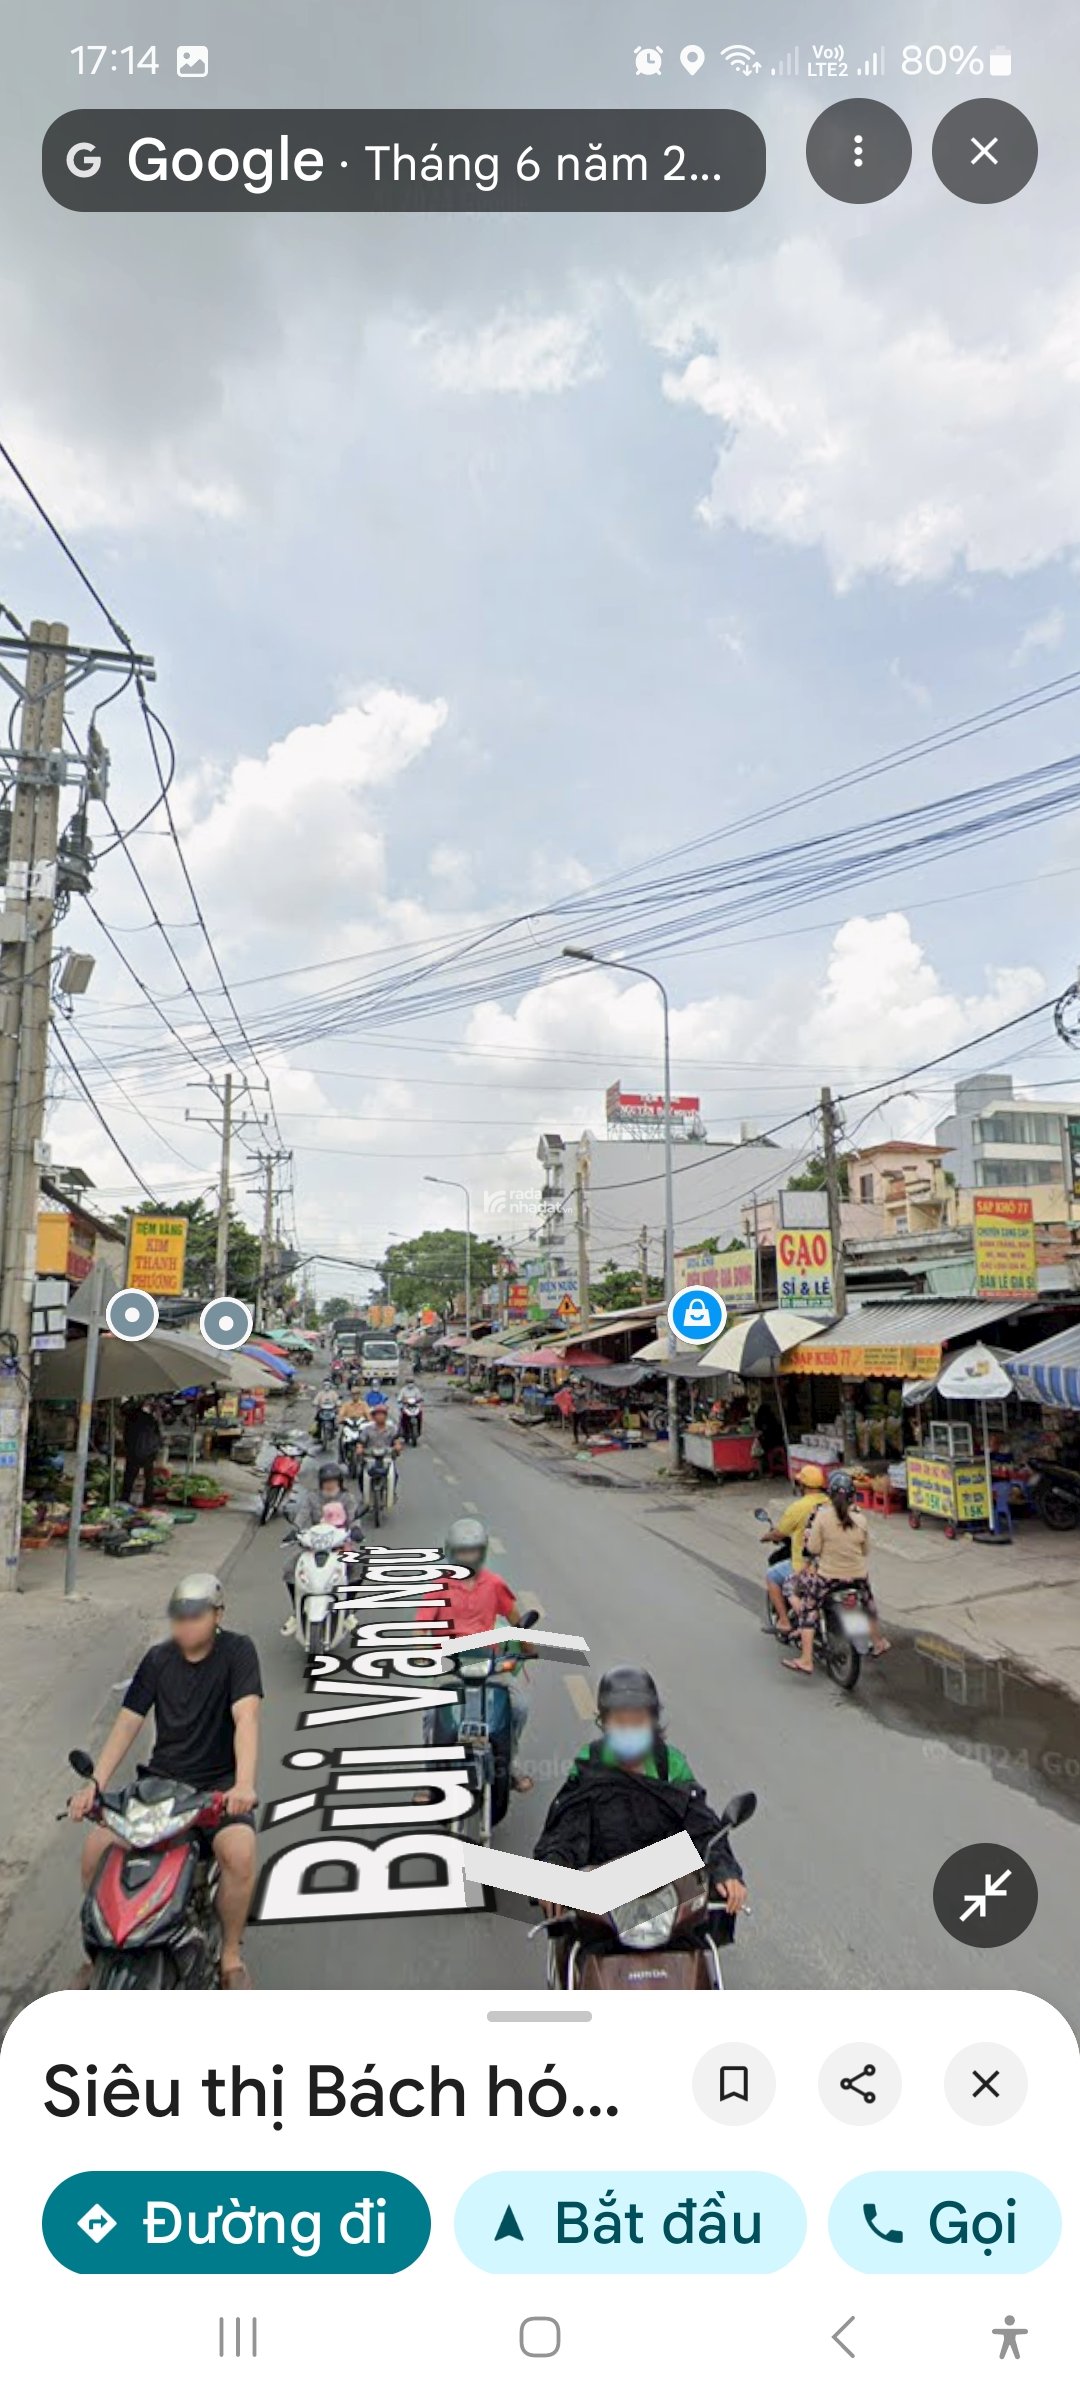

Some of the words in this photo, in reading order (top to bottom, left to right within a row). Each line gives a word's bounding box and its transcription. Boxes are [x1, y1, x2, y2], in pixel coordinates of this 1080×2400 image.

[146, 1237, 169, 1252] KIM
[135, 1255, 177, 1271] THANH
[780, 1234, 827, 1276] GẠO
[782, 1276, 796, 1296] SỈ
[800, 1281, 810, 1296] &
[814, 1276, 831, 1296] LẺ
